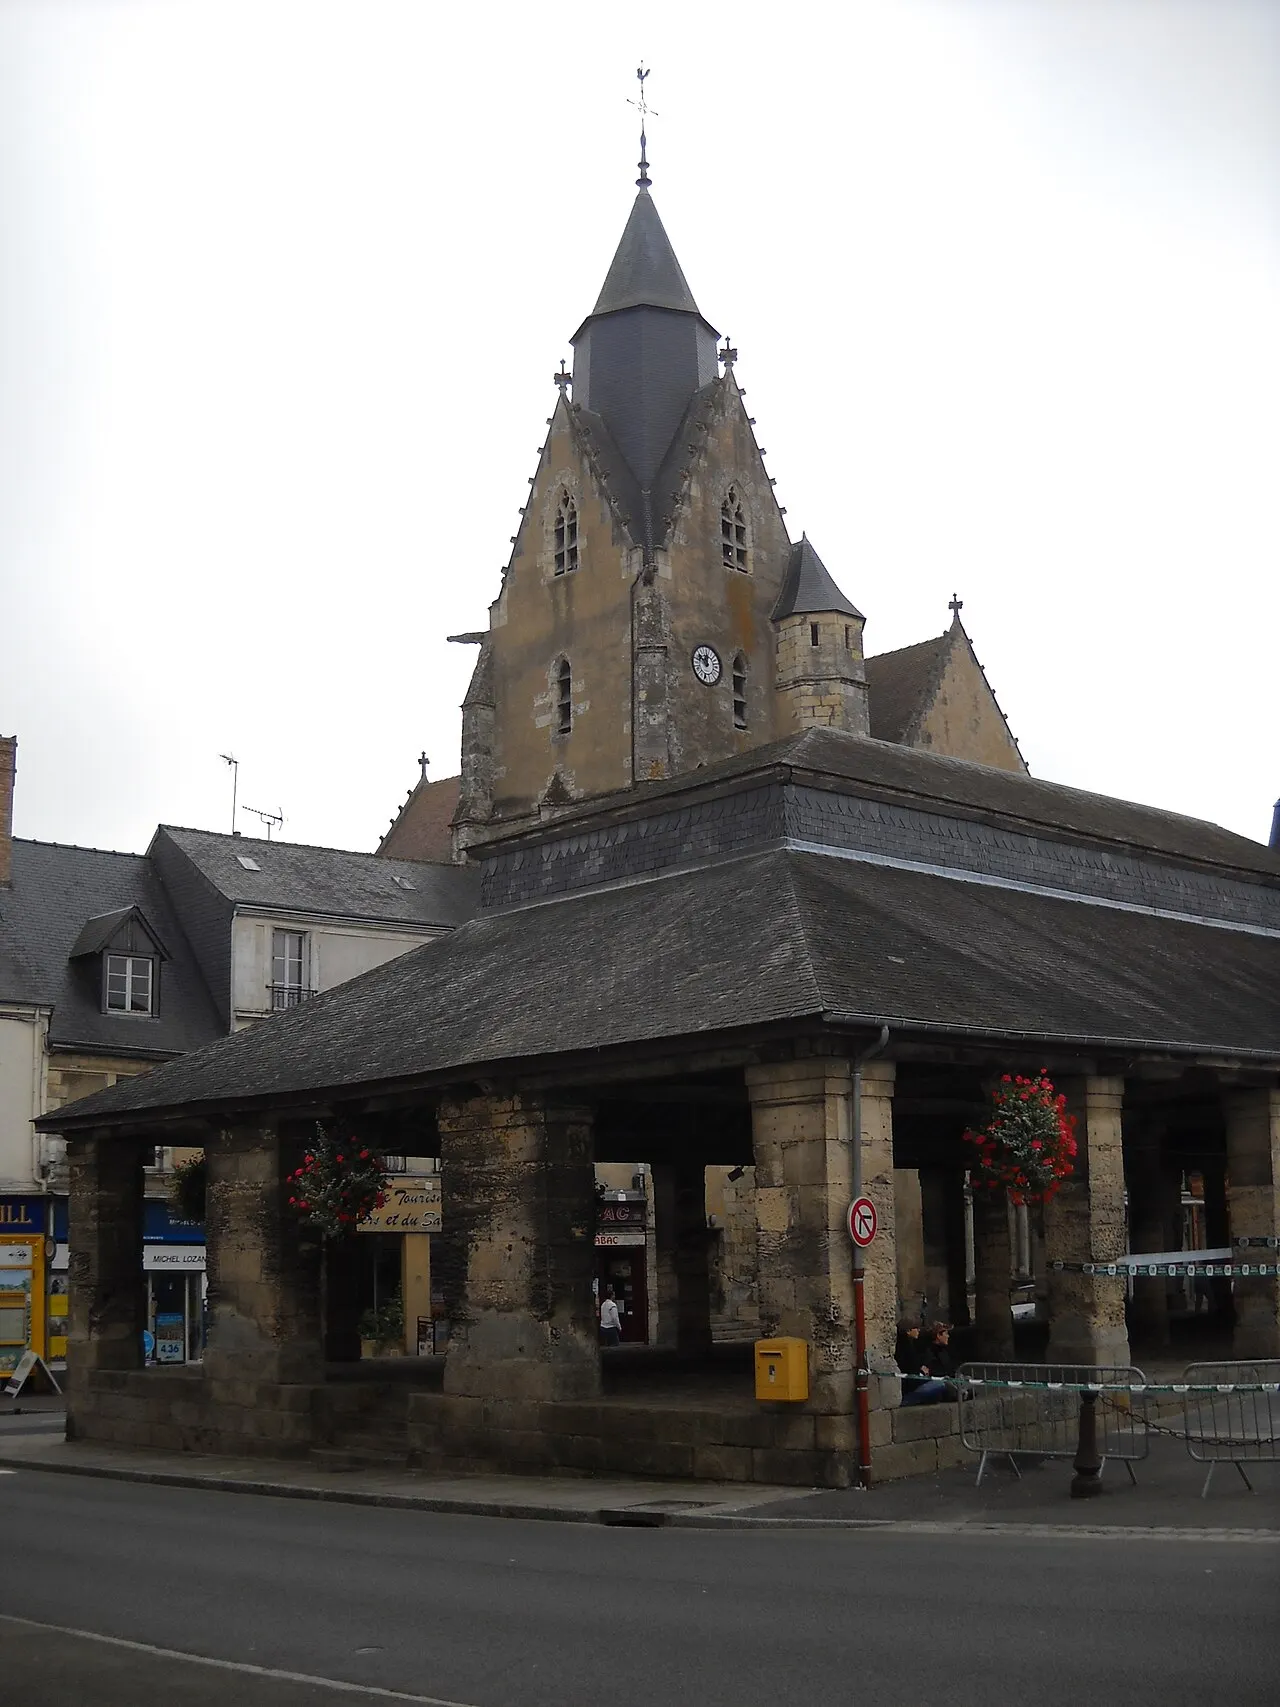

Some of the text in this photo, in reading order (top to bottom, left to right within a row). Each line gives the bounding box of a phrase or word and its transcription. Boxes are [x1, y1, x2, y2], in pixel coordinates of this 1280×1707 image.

[386, 1213, 399, 1225] et
[401, 1212, 417, 1226] du
[152, 1255, 180, 1263] MICHEL
